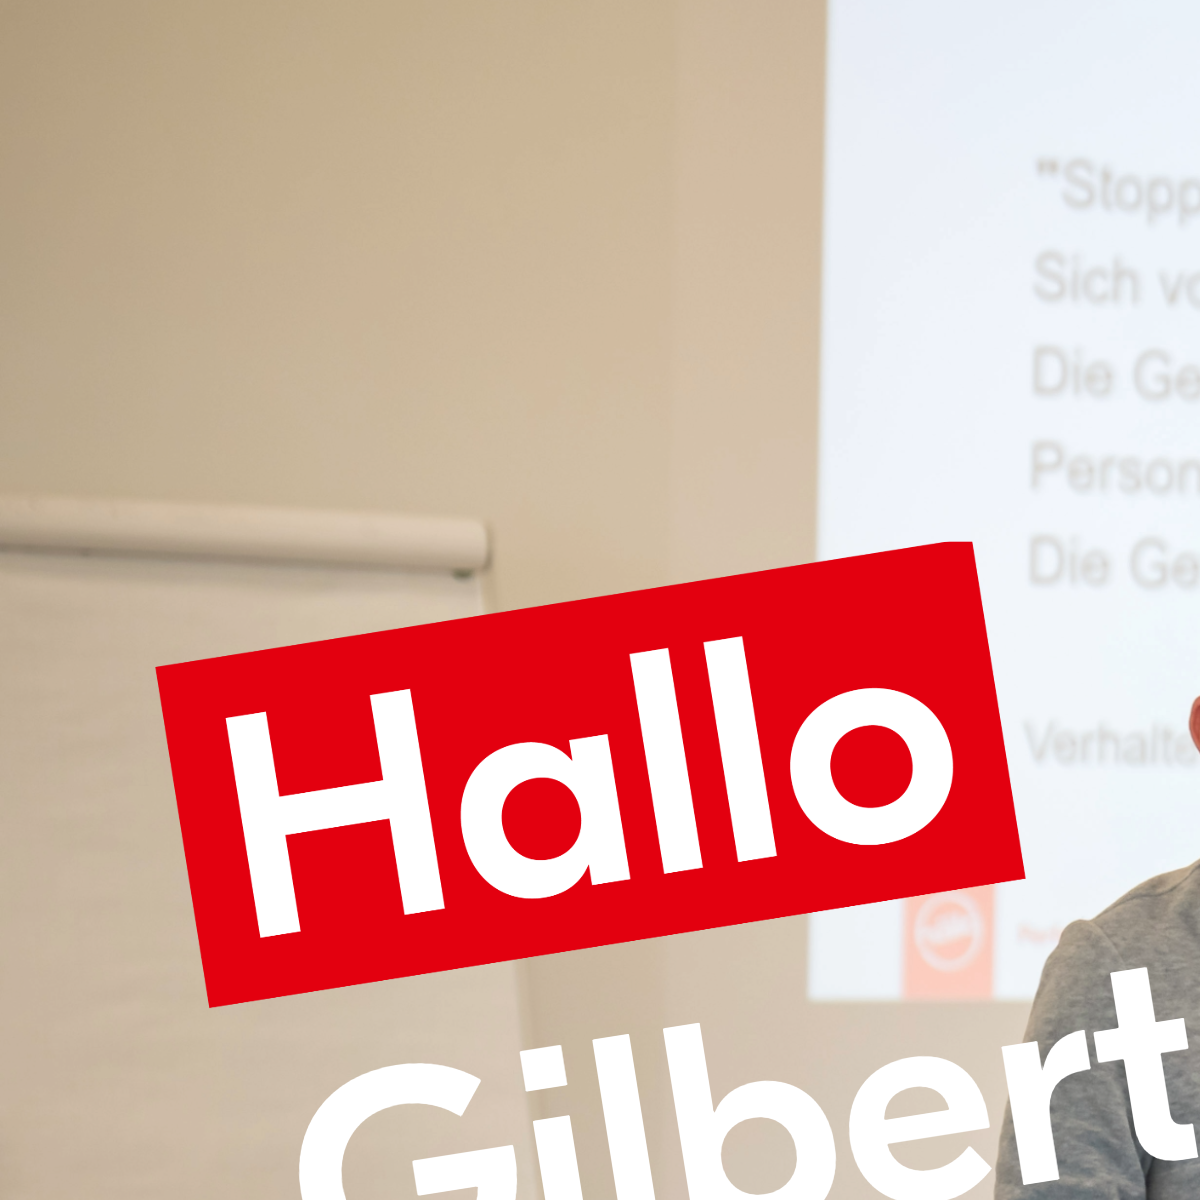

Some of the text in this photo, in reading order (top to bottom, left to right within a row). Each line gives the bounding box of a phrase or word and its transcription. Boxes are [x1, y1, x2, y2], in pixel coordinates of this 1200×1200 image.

[1032, 249, 1142, 306] Sich
[1032, 344, 1116, 399] Die
[1028, 533, 1112, 588] Die
